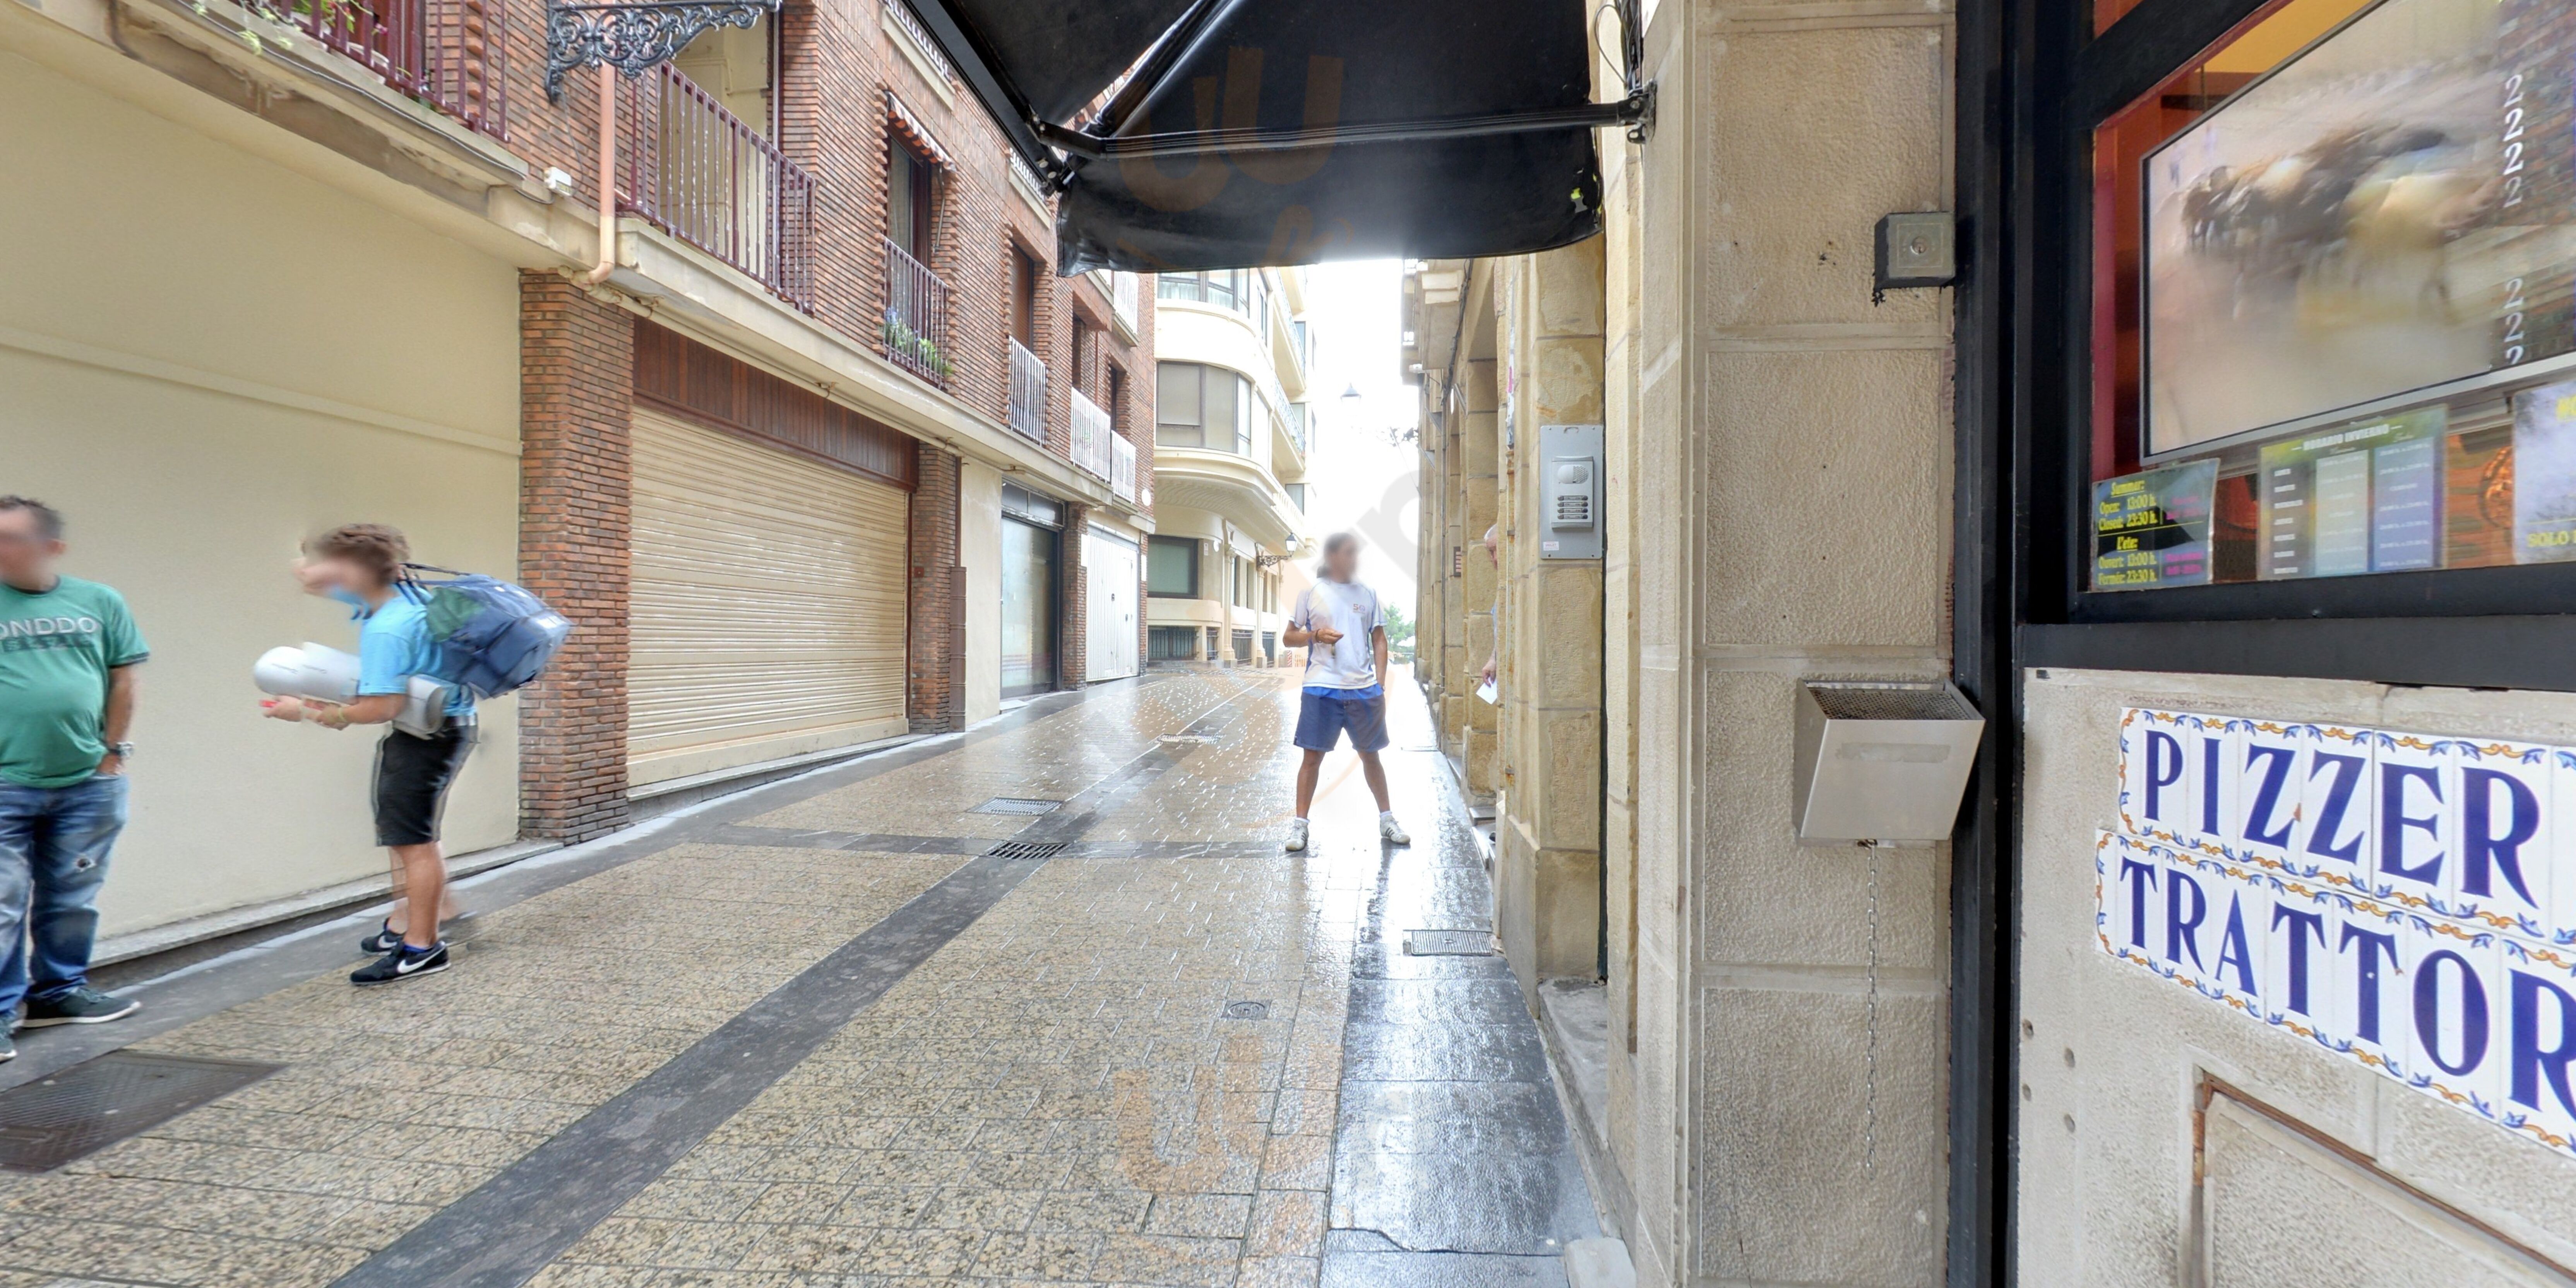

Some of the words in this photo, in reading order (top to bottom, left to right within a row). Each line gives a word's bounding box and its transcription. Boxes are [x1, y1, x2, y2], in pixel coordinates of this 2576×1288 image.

[2503, 108, 2524, 141] 2
[2503, 142, 2524, 175] 2
[2144, 729, 2540, 909] PIZZER
[2119, 855, 2576, 1122] TRATTOR
